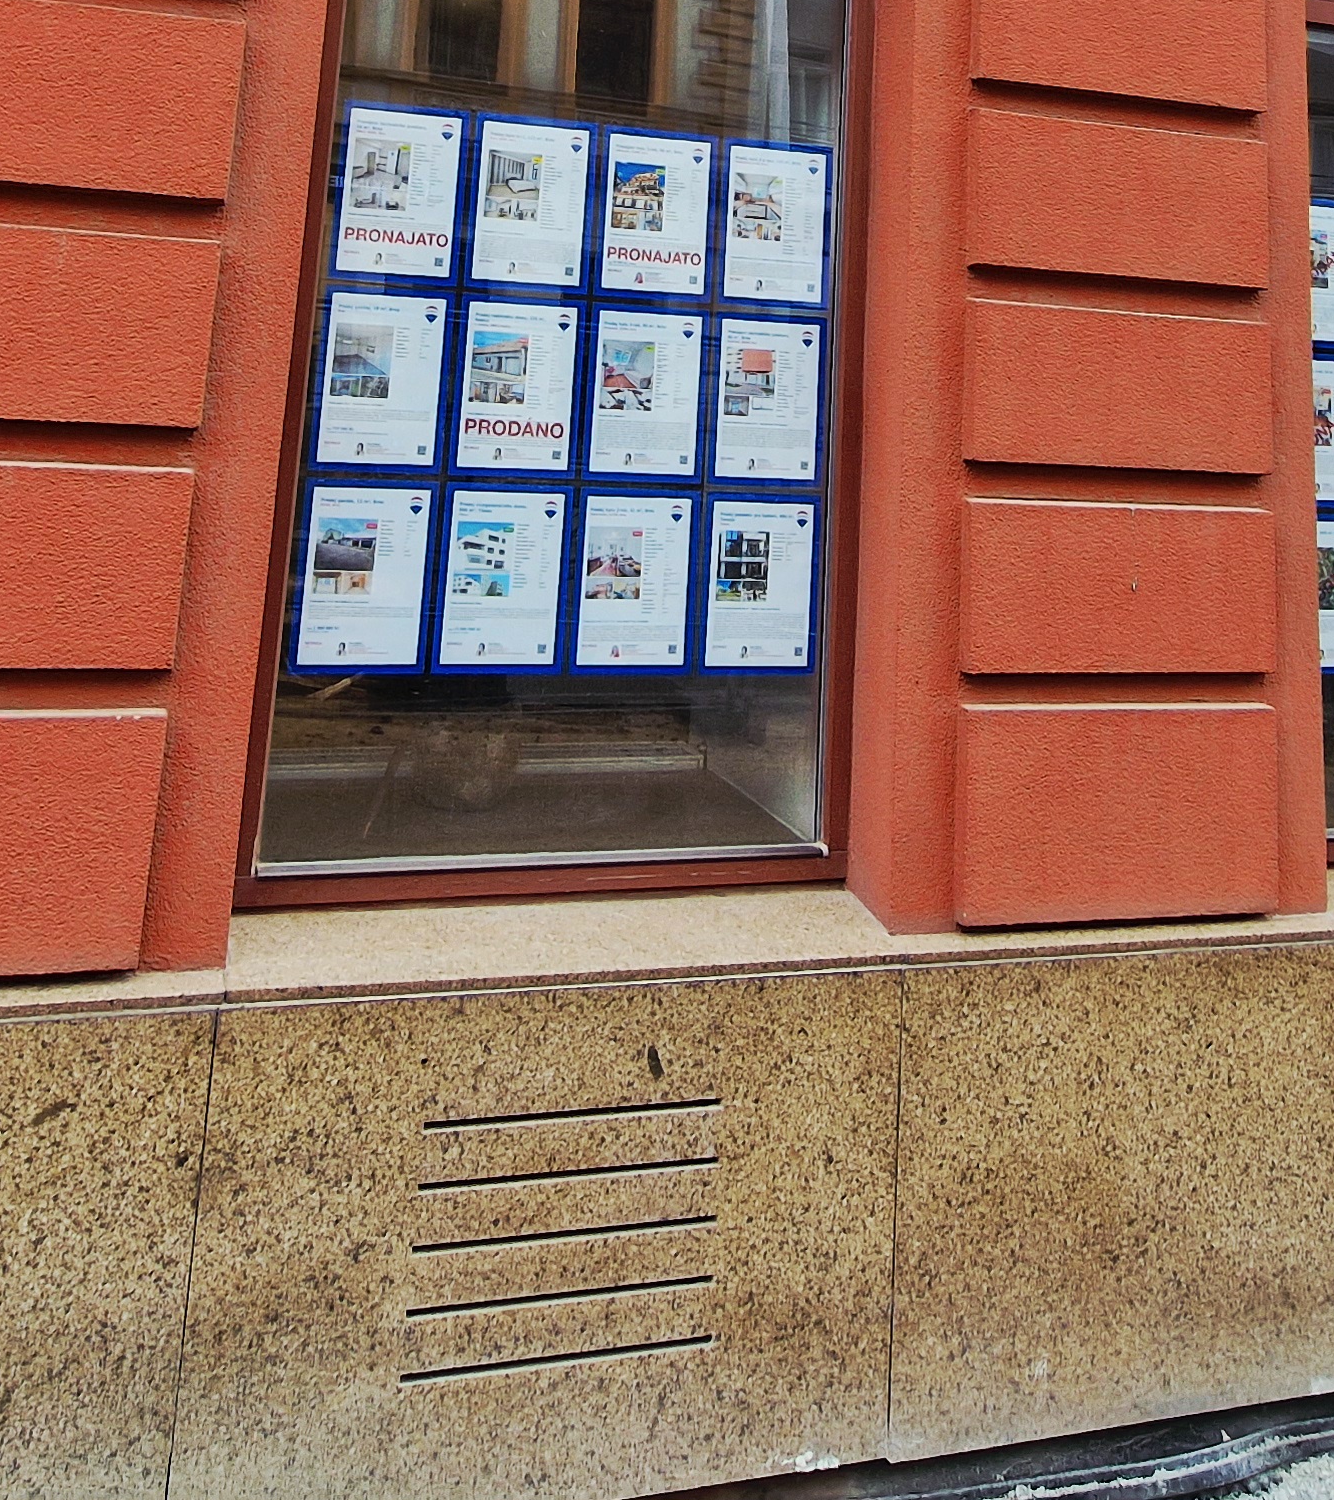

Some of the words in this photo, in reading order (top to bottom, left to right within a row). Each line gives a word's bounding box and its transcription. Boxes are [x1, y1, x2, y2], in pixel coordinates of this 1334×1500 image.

[343, 226, 449, 248] PRONAJATO
[607, 246, 702, 267] PRONAJATO
[464, 417, 565, 440] PRODÁNO
